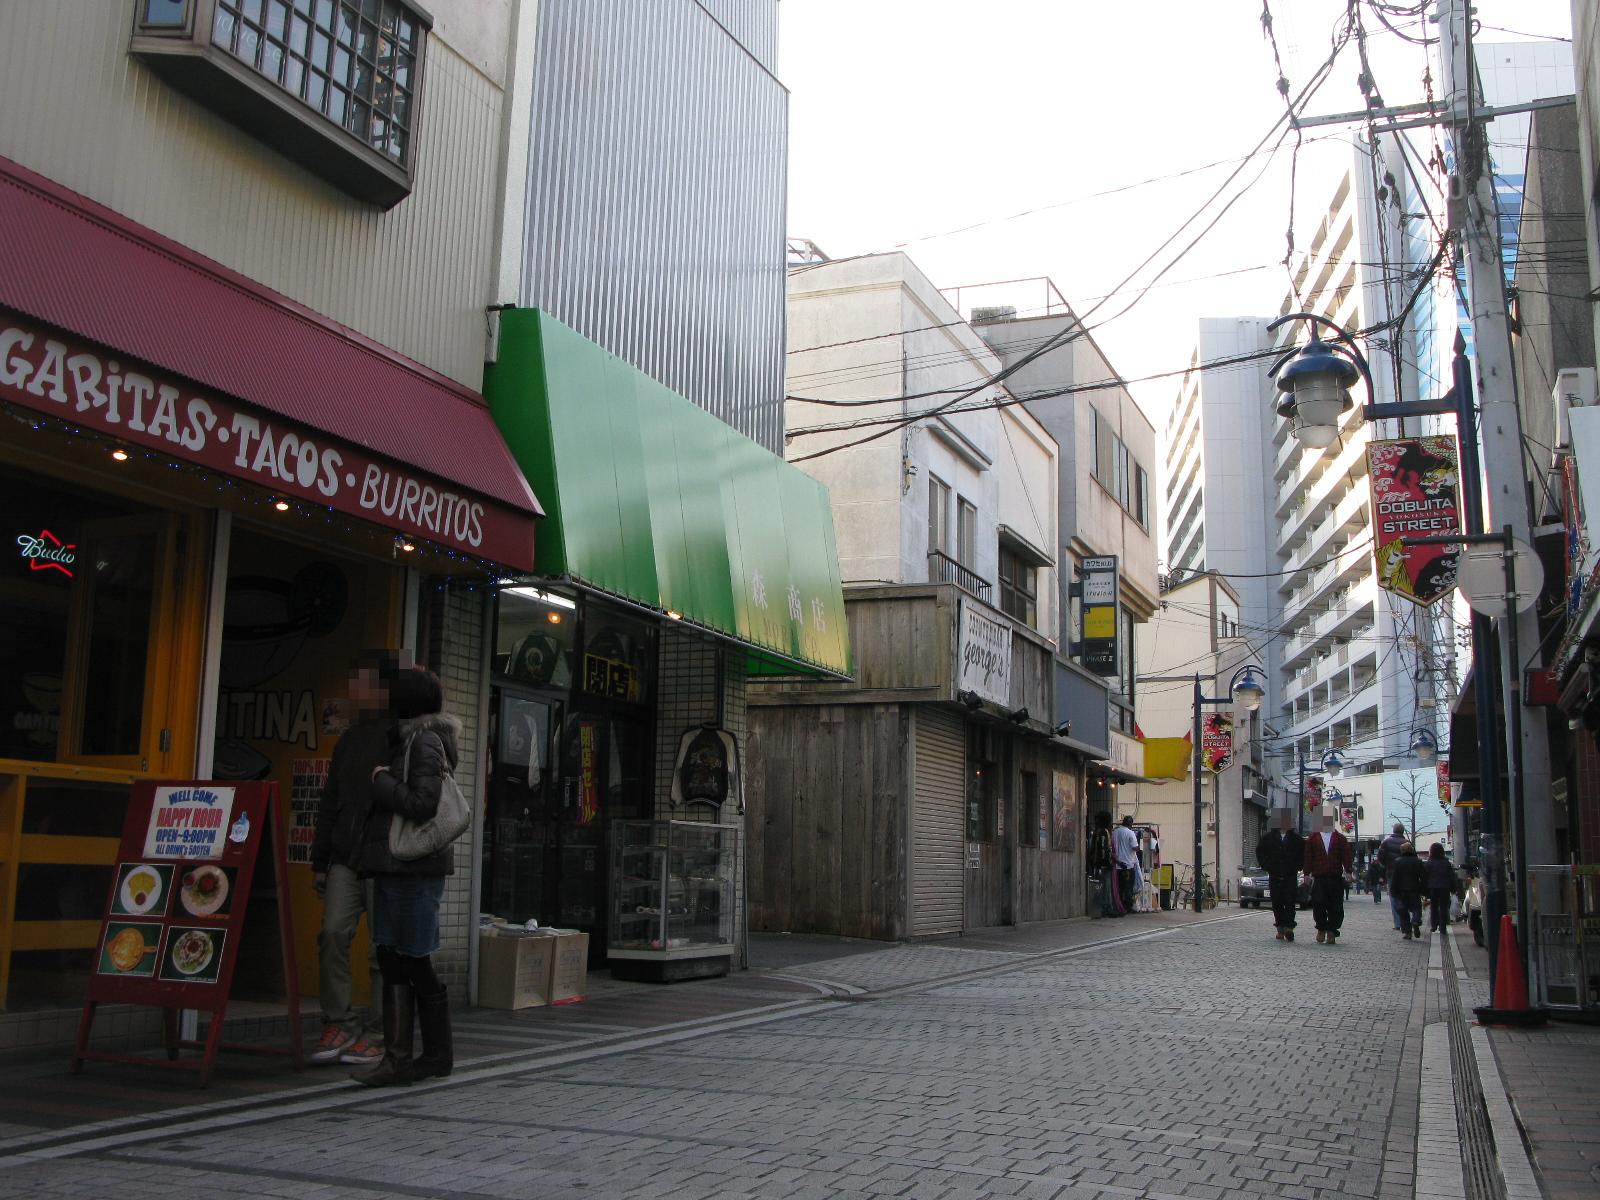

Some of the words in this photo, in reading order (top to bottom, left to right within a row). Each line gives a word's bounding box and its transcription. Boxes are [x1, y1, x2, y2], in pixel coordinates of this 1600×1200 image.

[231, 413, 343, 497] TACOS
[359, 464, 485, 548] BURRITOS
[1379, 498, 1454, 514] DOBUITA
[1383, 517, 1454, 533] STREET
[216, 690, 318, 750] TINA
[156, 808, 193, 828] HAPPY
[191, 808, 223, 829] HOUR
[155, 844, 164, 855] ALL
